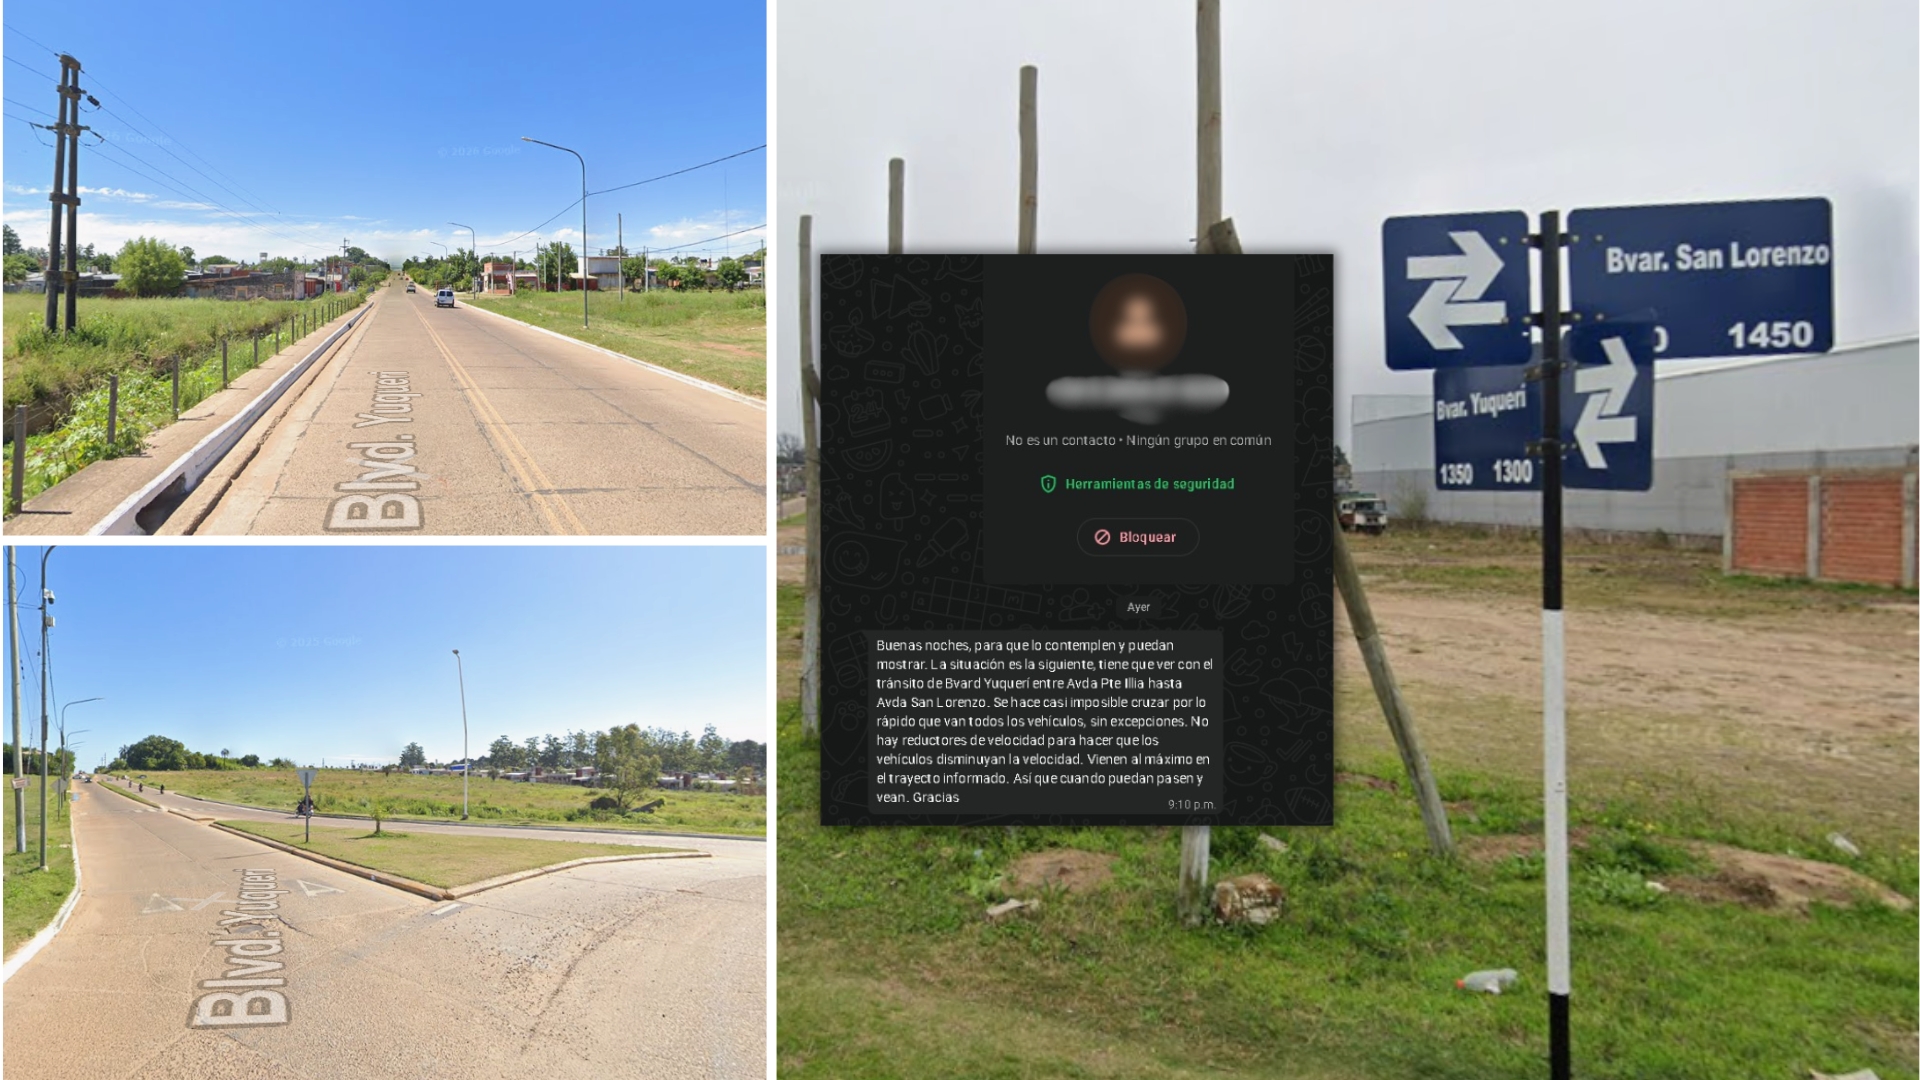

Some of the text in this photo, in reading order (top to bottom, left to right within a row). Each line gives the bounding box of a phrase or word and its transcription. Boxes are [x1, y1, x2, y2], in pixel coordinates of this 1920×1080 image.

[1606, 241, 1830, 273] Bvar. San Lorenzo
[1728, 320, 1814, 349] 1450
[1436, 400, 1468, 421] Bvar.
[1440, 459, 1533, 485] 1350 1300
